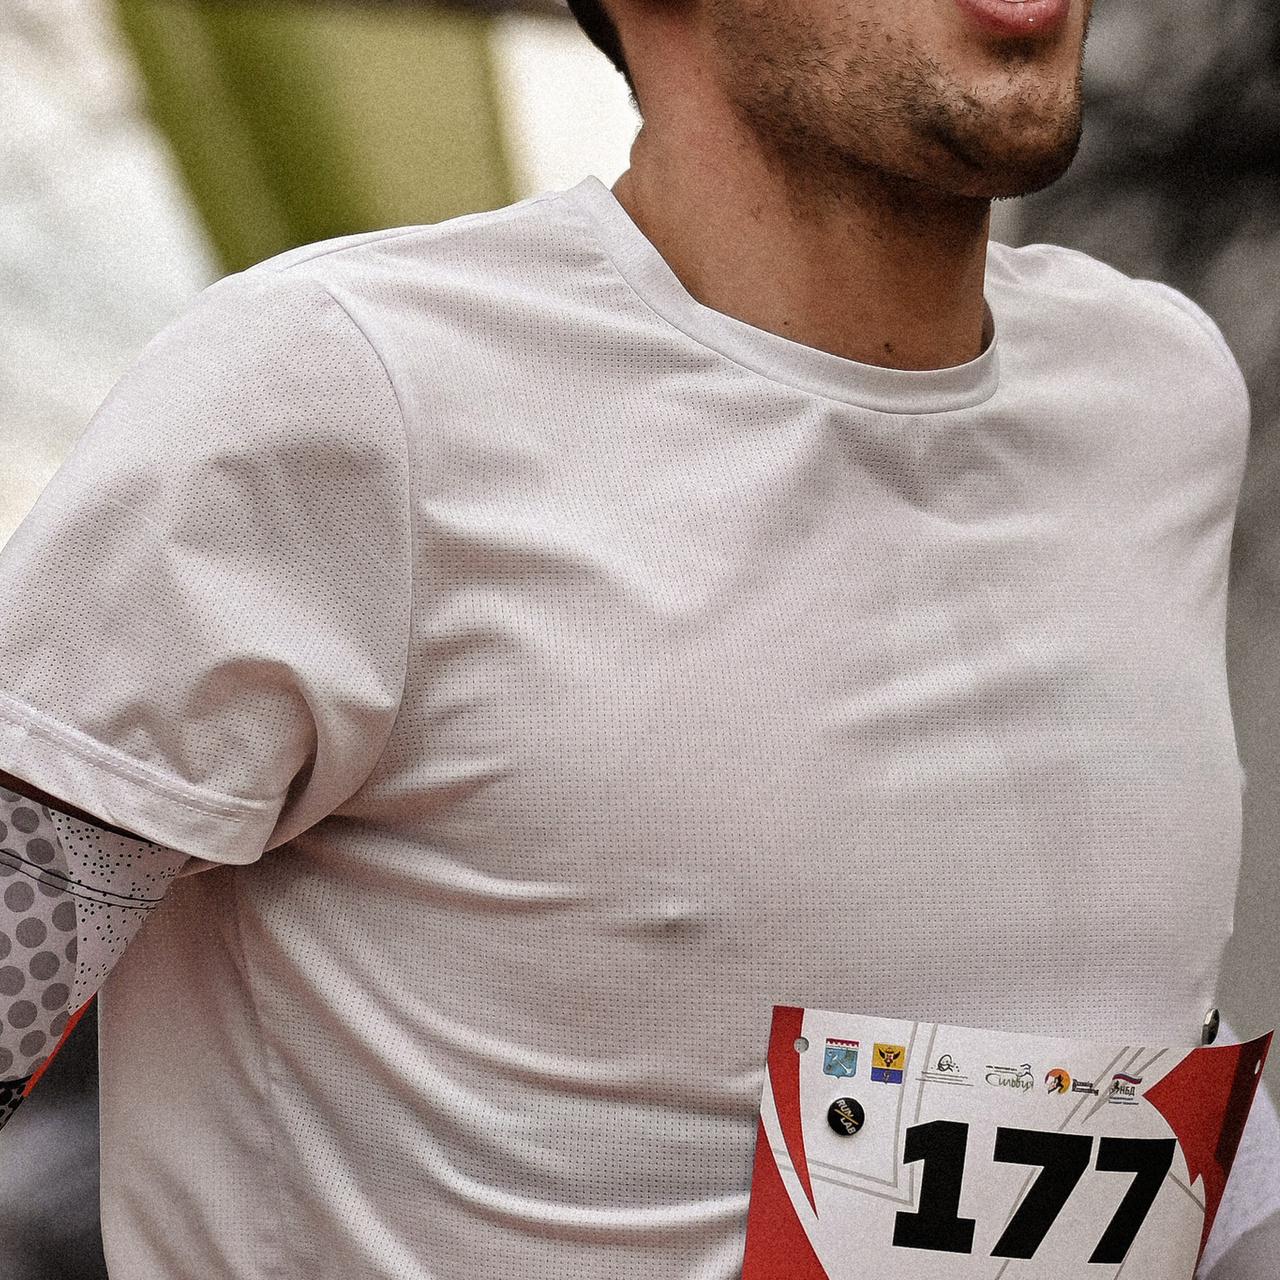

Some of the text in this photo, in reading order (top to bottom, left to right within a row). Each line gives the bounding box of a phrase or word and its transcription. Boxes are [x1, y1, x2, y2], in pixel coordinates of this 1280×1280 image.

[835, 1099, 855, 1117] RUN
[840, 1117, 856, 1134] LAB
[892, 1119, 1177, 1264] 177
